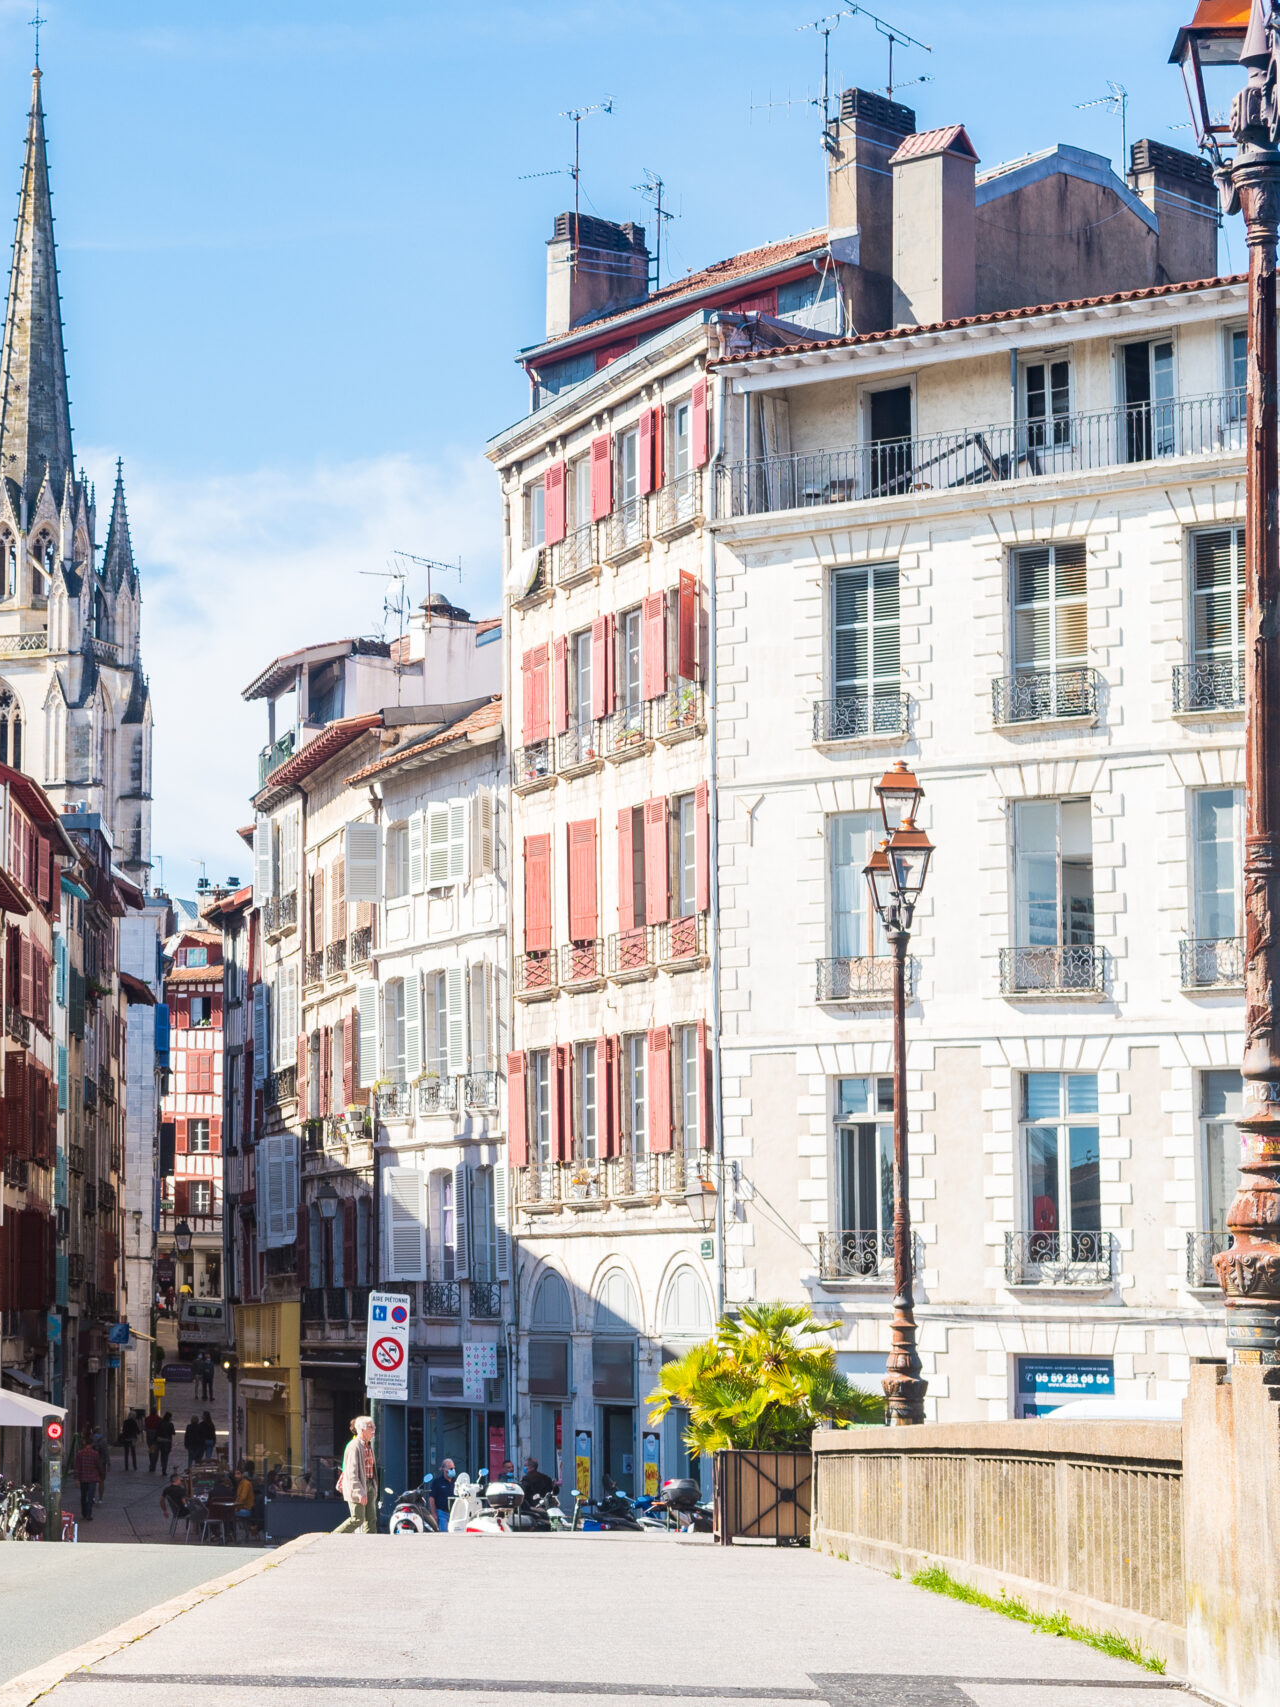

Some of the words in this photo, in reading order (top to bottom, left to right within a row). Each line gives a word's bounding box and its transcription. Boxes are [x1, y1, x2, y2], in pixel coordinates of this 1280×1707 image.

[385, 1296, 408, 1304] PIÉTONNE
[1035, 1373, 1049, 1382] 05
[1051, 1373, 1063, 1383] 59
[1065, 1373, 1078, 1383] 25
[1080, 1374, 1094, 1384] 68
[1096, 1374, 1109, 1384] 56
